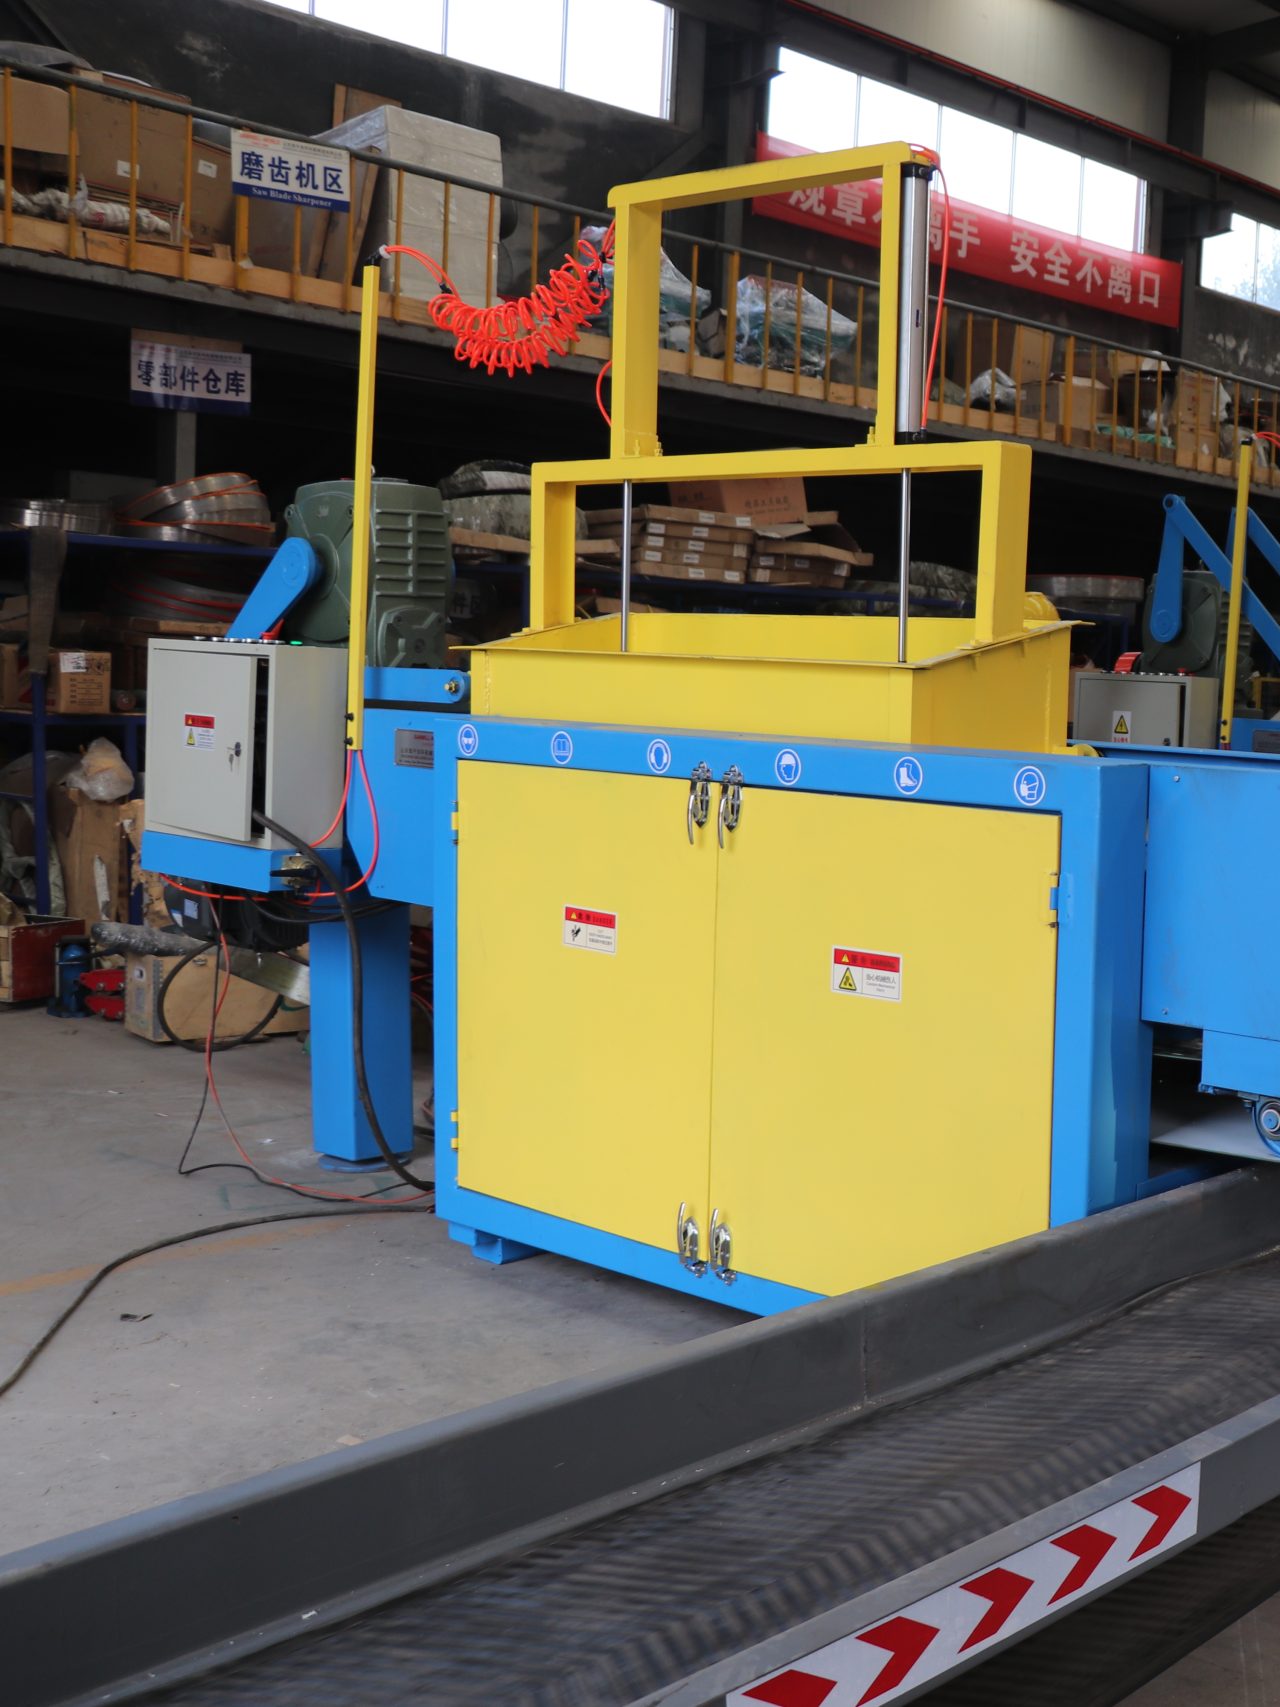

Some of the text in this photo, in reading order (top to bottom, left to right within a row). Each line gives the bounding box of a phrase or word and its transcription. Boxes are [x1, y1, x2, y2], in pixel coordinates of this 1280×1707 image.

[240, 151, 344, 194] 磨齿机区
[252, 187, 332, 207] Saw Blade Sharpener
[788, 180, 1161, 308] 规章手 安全不离口
[137, 360, 246, 397] 零部件仓库
